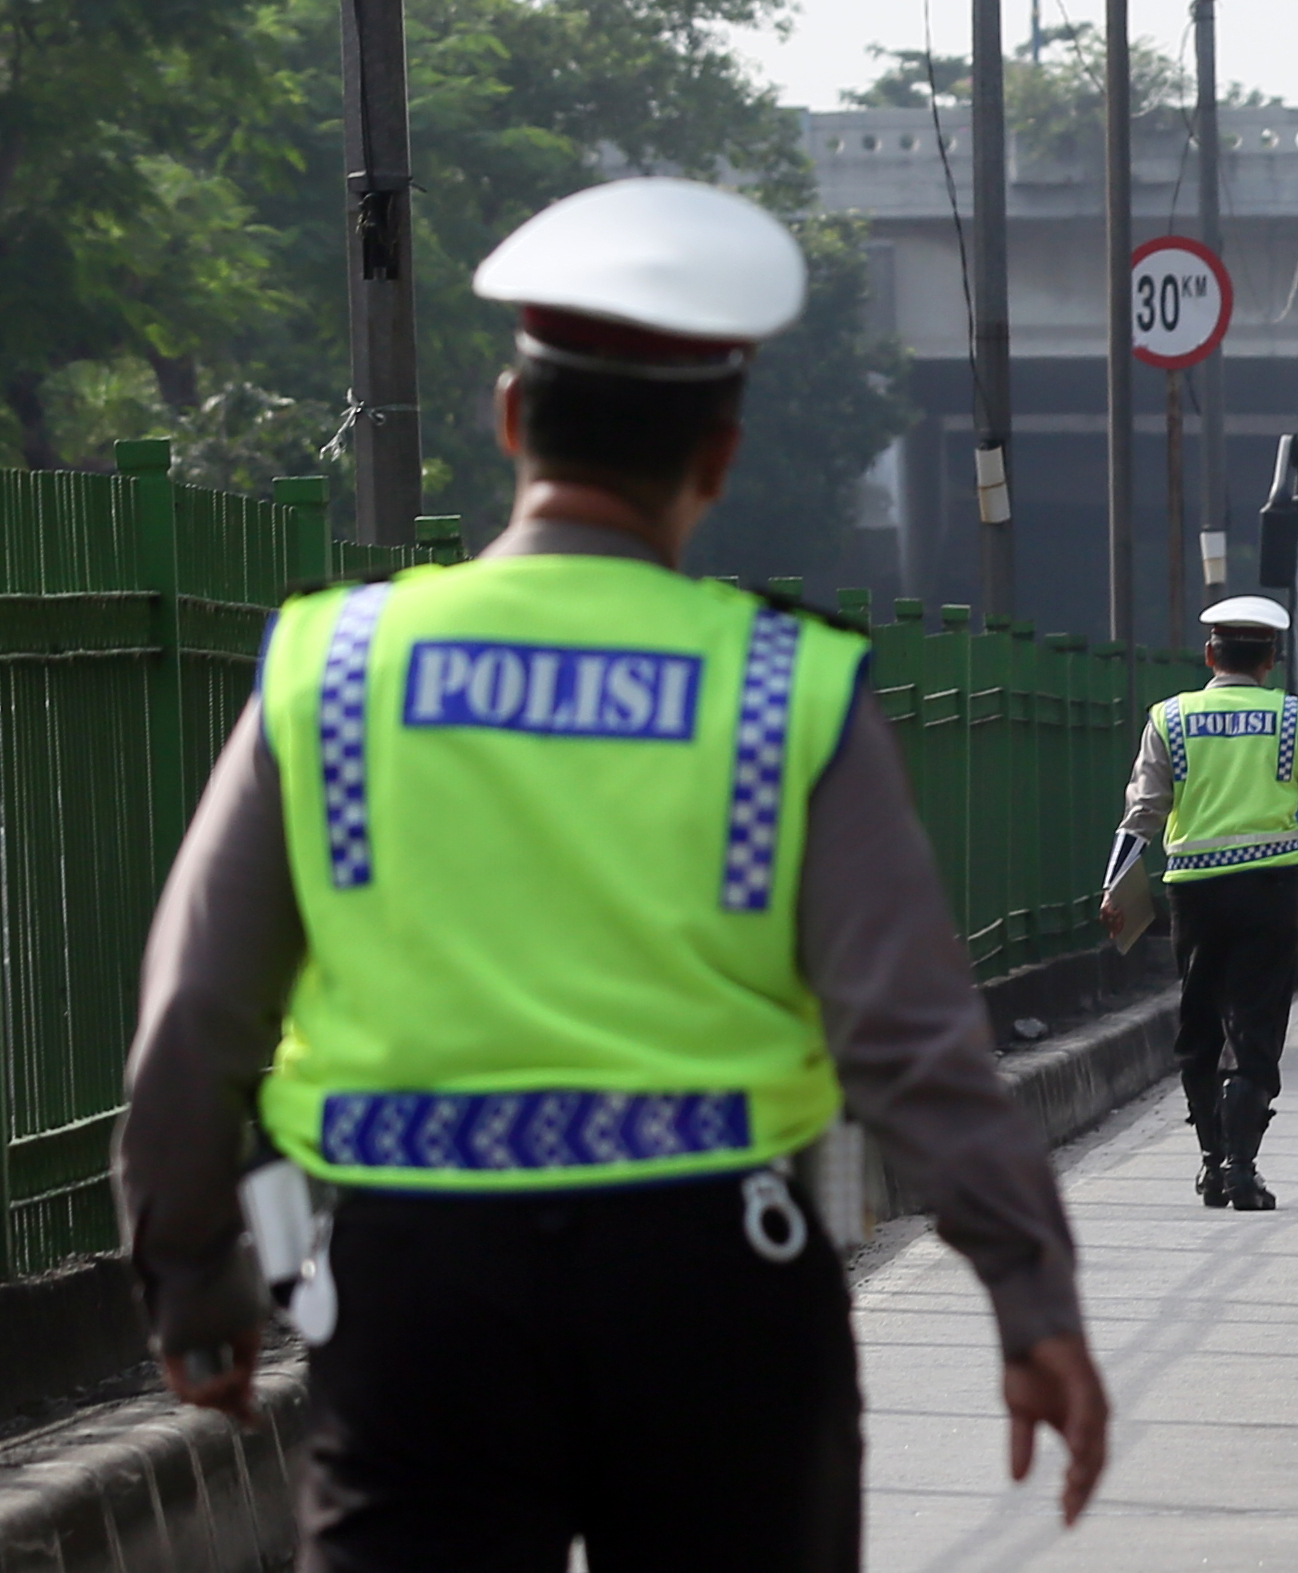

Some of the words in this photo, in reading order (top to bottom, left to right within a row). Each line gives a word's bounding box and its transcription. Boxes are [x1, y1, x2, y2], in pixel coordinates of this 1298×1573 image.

[1137, 274, 1180, 332] 30
[1182, 275, 1207, 297] KM
[411, 647, 691, 733] POLISI
[1188, 711, 1275, 736] POLISI
